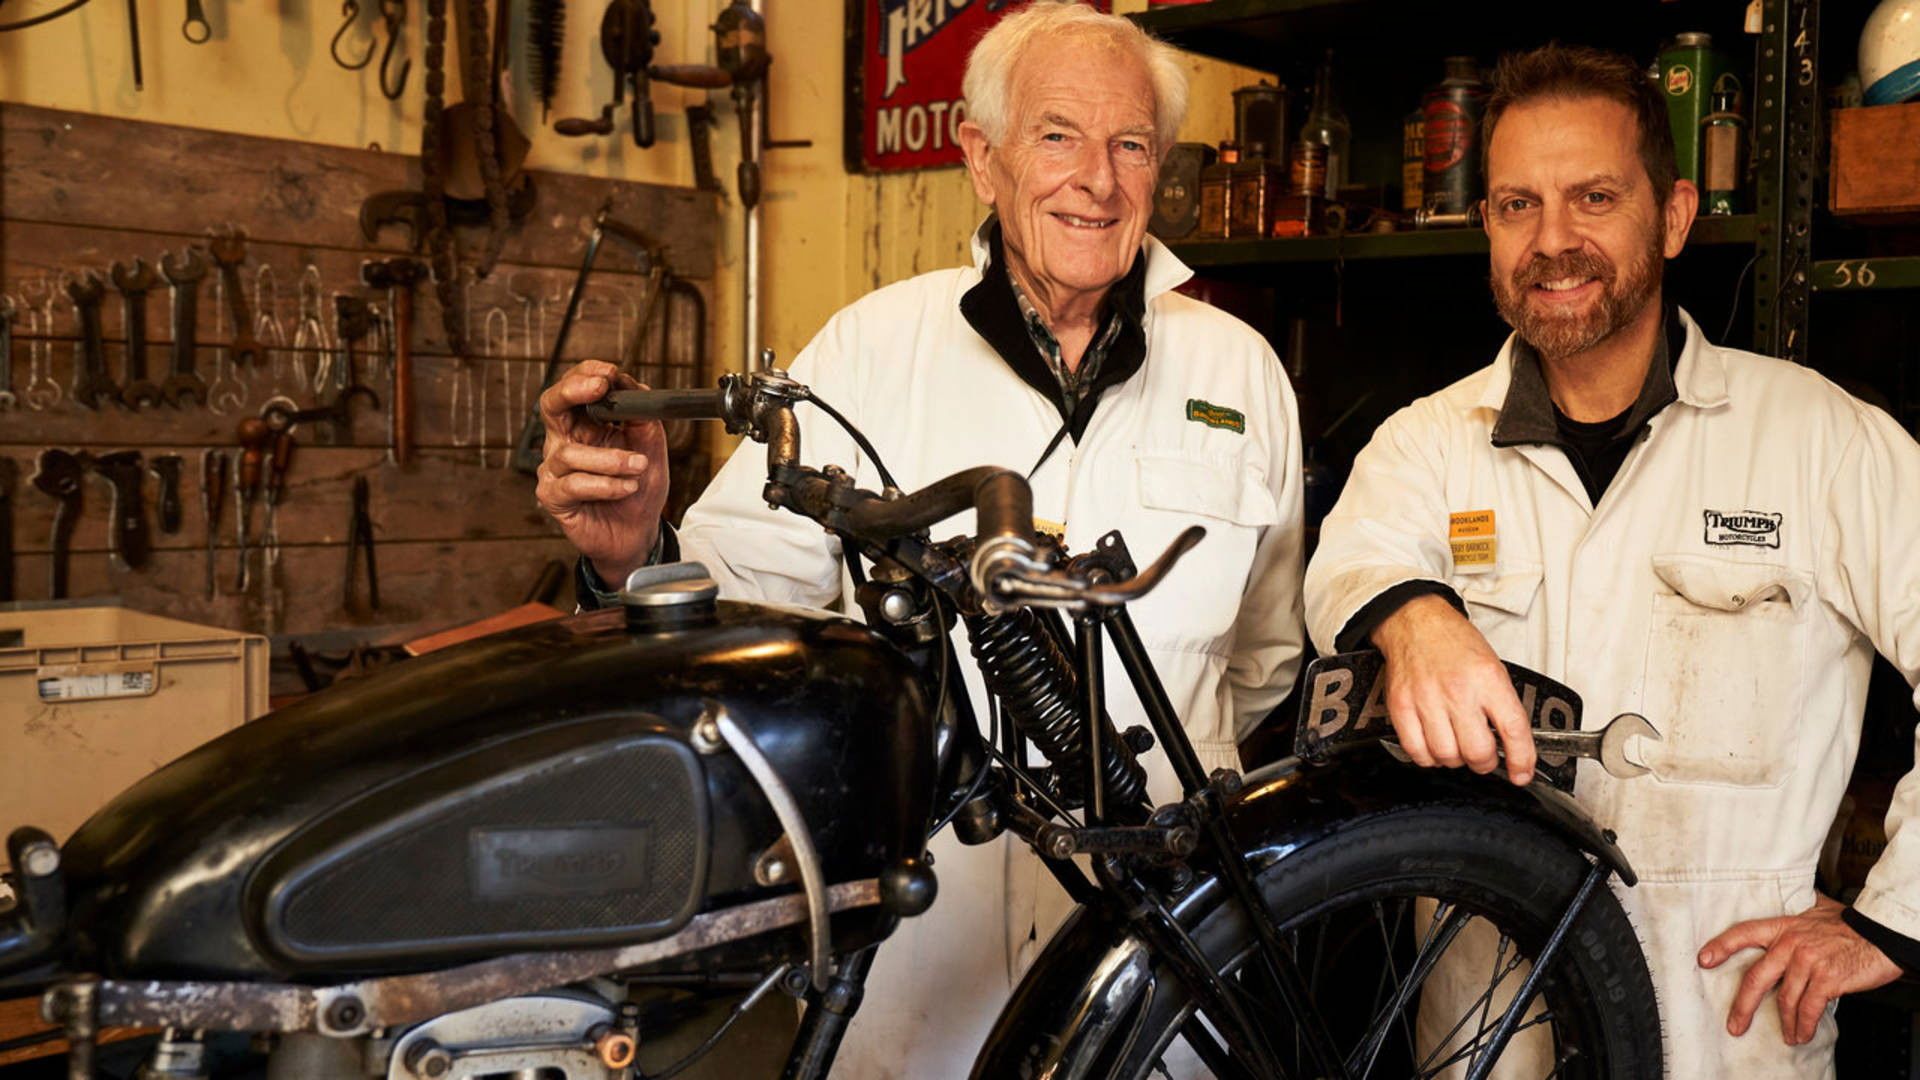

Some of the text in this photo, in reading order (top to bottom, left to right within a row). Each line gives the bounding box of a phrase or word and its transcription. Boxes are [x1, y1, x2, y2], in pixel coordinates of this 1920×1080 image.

[884, 0, 968, 99] TRI
[876, 98, 968, 155] MOTO
[1708, 513, 1777, 532] TRIUMPH
